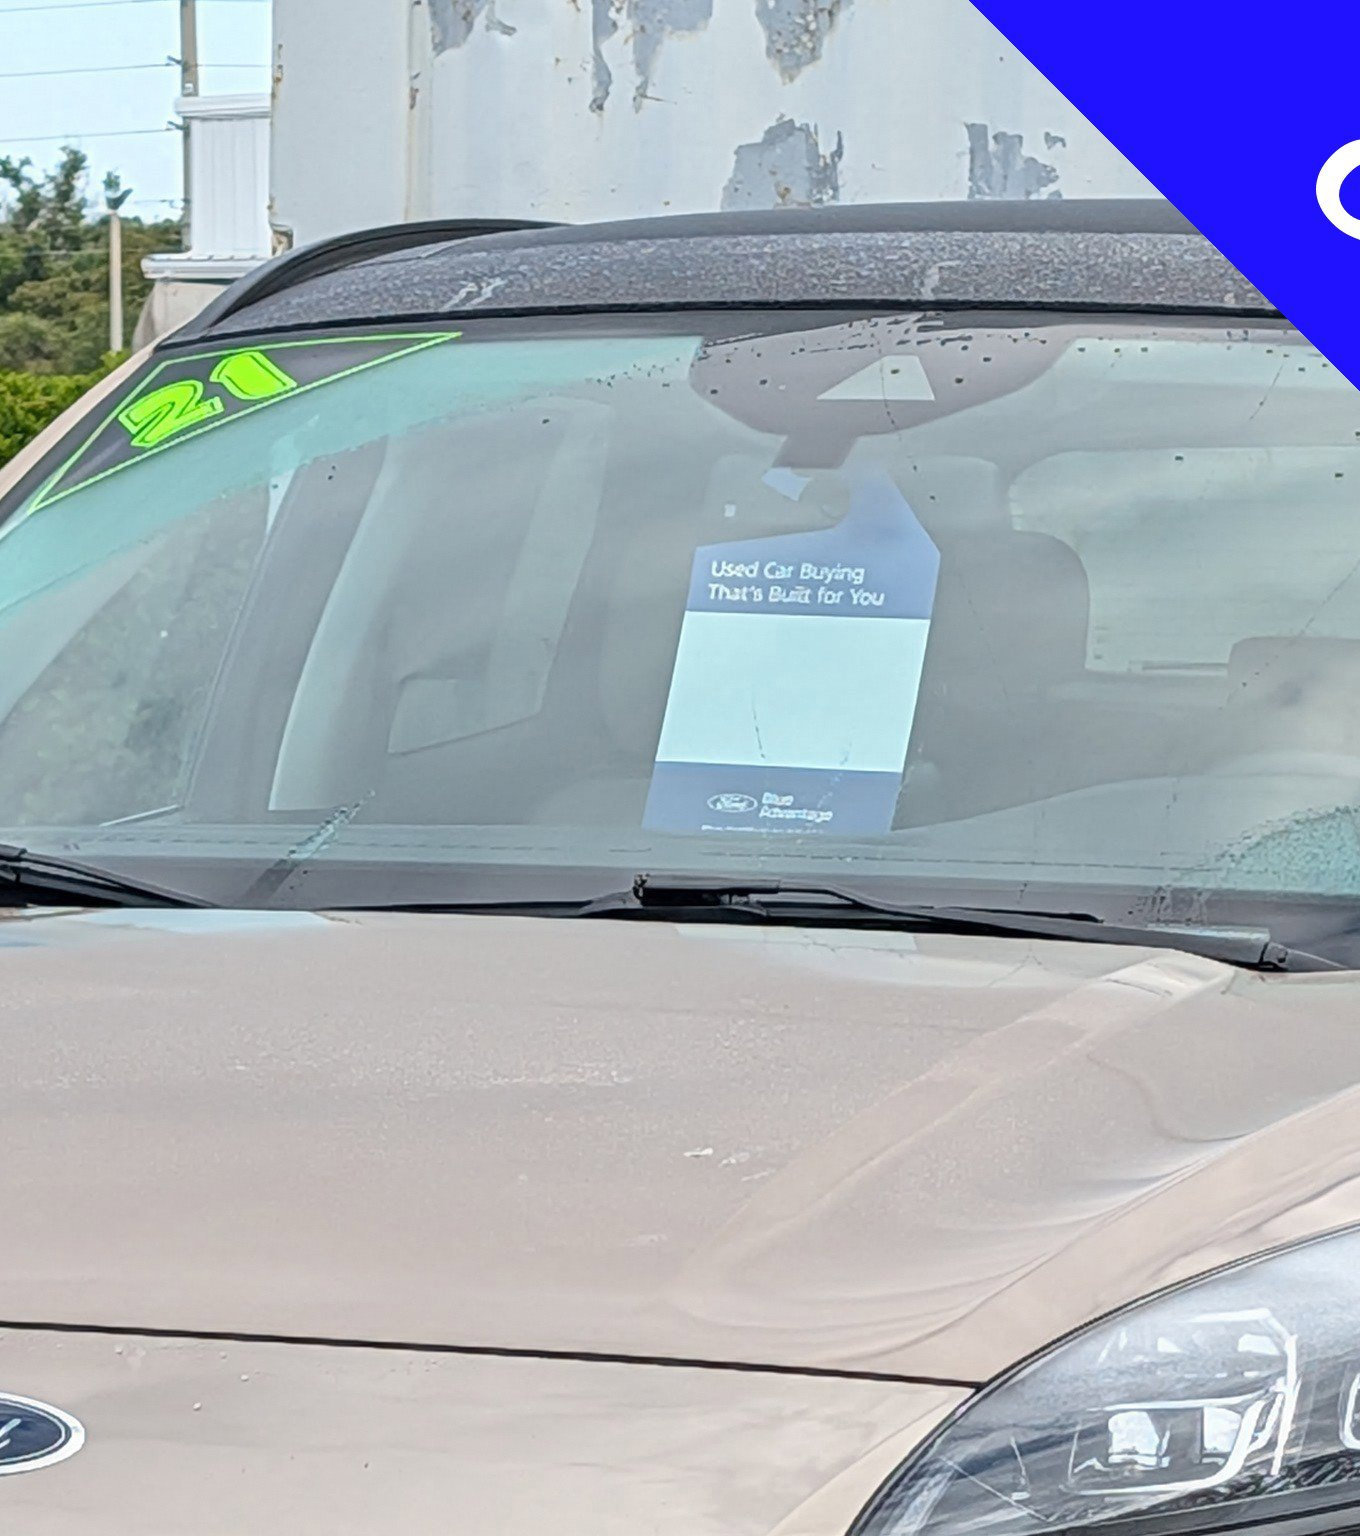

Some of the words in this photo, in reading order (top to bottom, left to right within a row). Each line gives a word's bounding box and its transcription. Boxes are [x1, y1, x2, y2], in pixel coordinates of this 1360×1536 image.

[118, 350, 298, 448] 21
[711, 560, 760, 578] Used
[763, 561, 795, 579] Car
[800, 562, 866, 585] Buying
[708, 583, 764, 601] That's
[768, 585, 811, 604] Built
[817, 586, 845, 604] for
[849, 588, 886, 606] You
